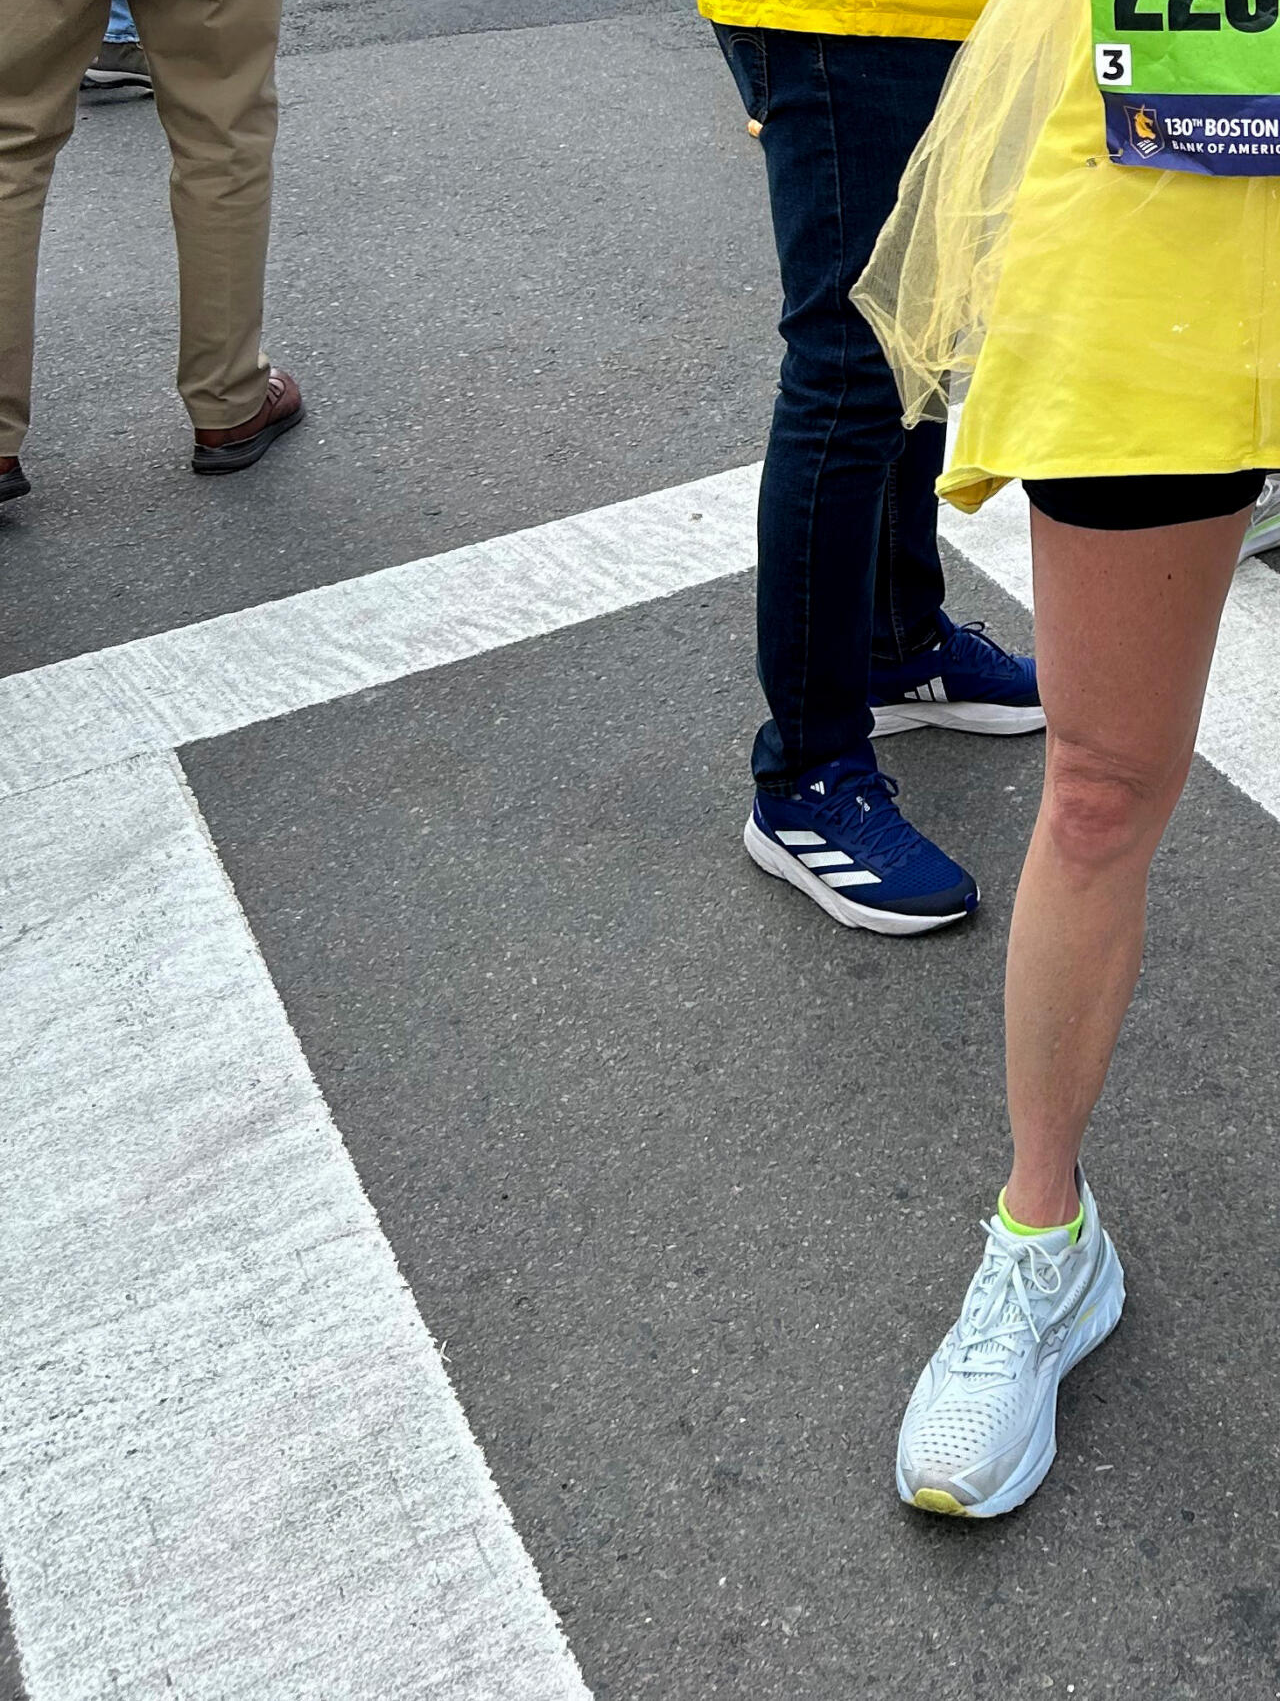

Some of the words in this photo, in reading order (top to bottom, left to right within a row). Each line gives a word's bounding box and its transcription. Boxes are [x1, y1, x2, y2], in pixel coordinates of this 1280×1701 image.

[1102, 49, 1124, 81] 3
[1164, 118, 1203, 137] 130TH
[1205, 119, 1278, 138] BOSTON
[1172, 140, 1204, 153] BANK
[1207, 143, 1225, 154] OF
